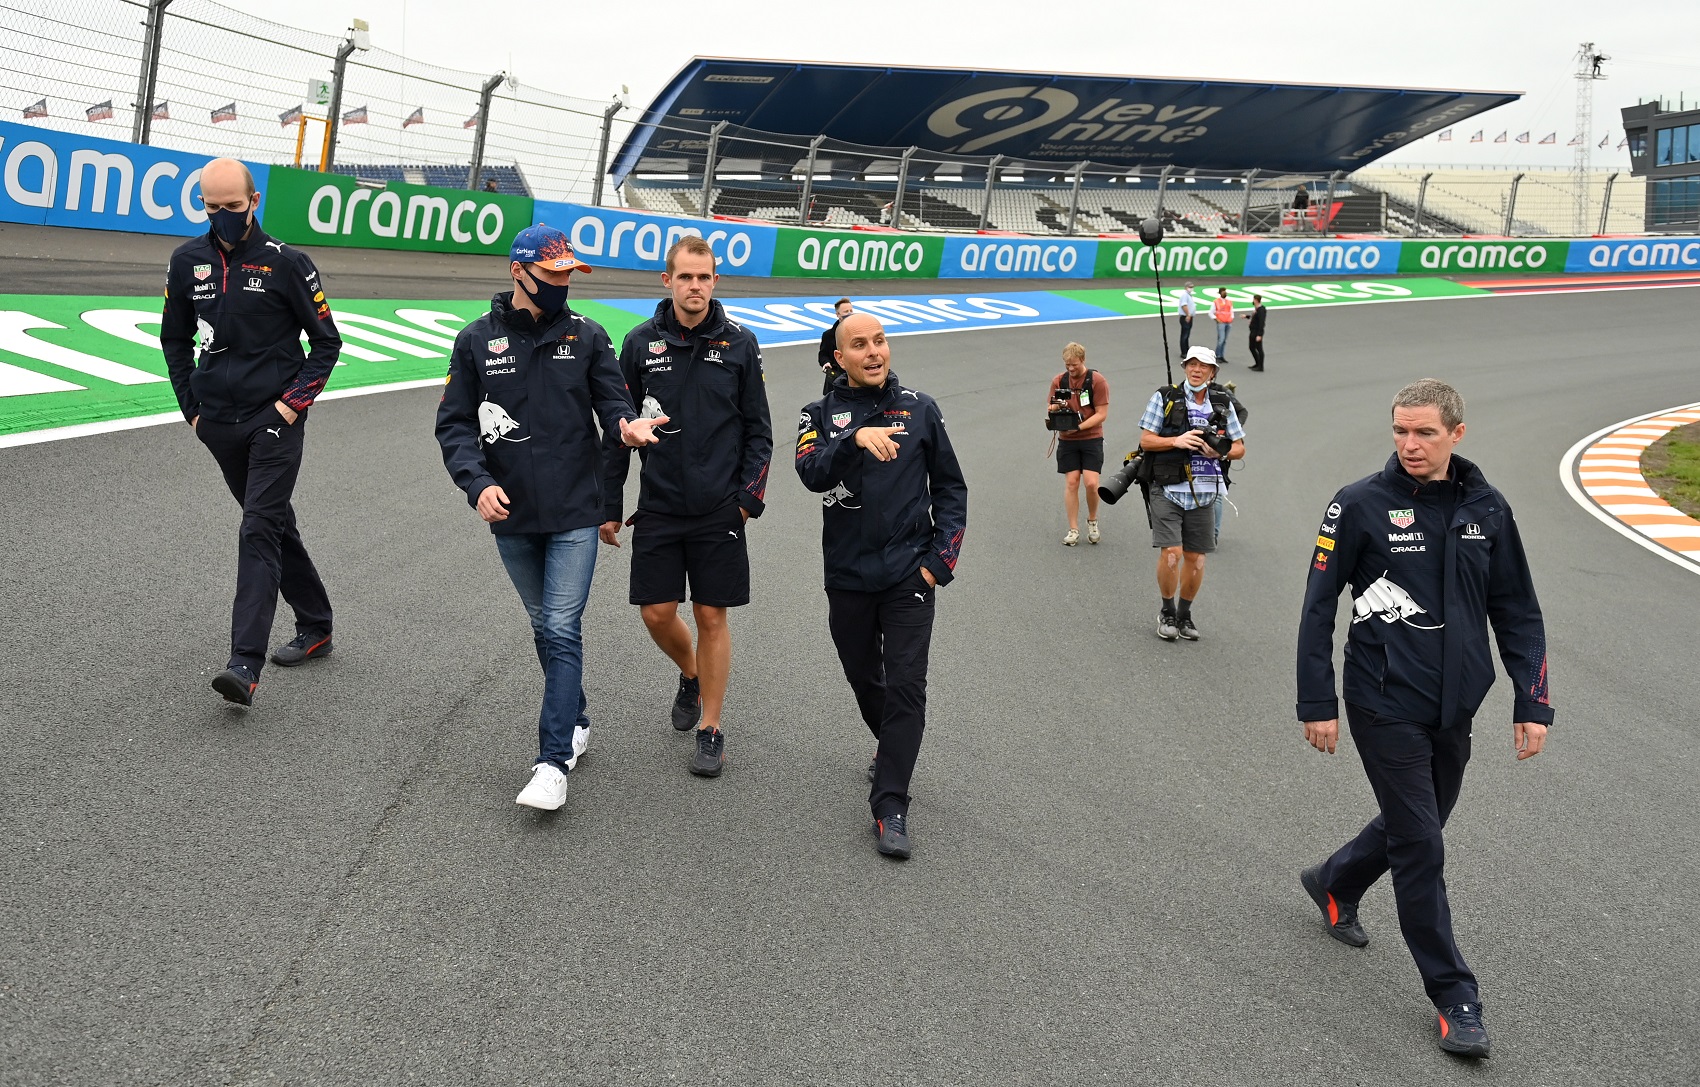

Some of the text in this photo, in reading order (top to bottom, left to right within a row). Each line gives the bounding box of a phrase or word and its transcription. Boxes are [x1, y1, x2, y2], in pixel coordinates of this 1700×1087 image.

[1078, 98, 1223, 123] levi
[1048, 121, 1208, 144] nine
[308, 185, 504, 245] aramco
[798, 237, 924, 272] aramco
[960, 243, 1078, 273] aramco
[1115, 245, 1228, 272] aramco
[1265, 245, 1381, 270] aramco
[1420, 245, 1547, 269] aramco
[194, 284, 209, 292] Mobil
[490, 337, 508, 347] TAG
[486, 356, 507, 366] Mobil
[645, 357, 665, 365] Mobil
[486, 367, 517, 376] ORACLE
[1390, 510, 1413, 518] TAG
[1388, 532, 1415, 542] Mobil
[1390, 545, 1426, 553] ORACLE
